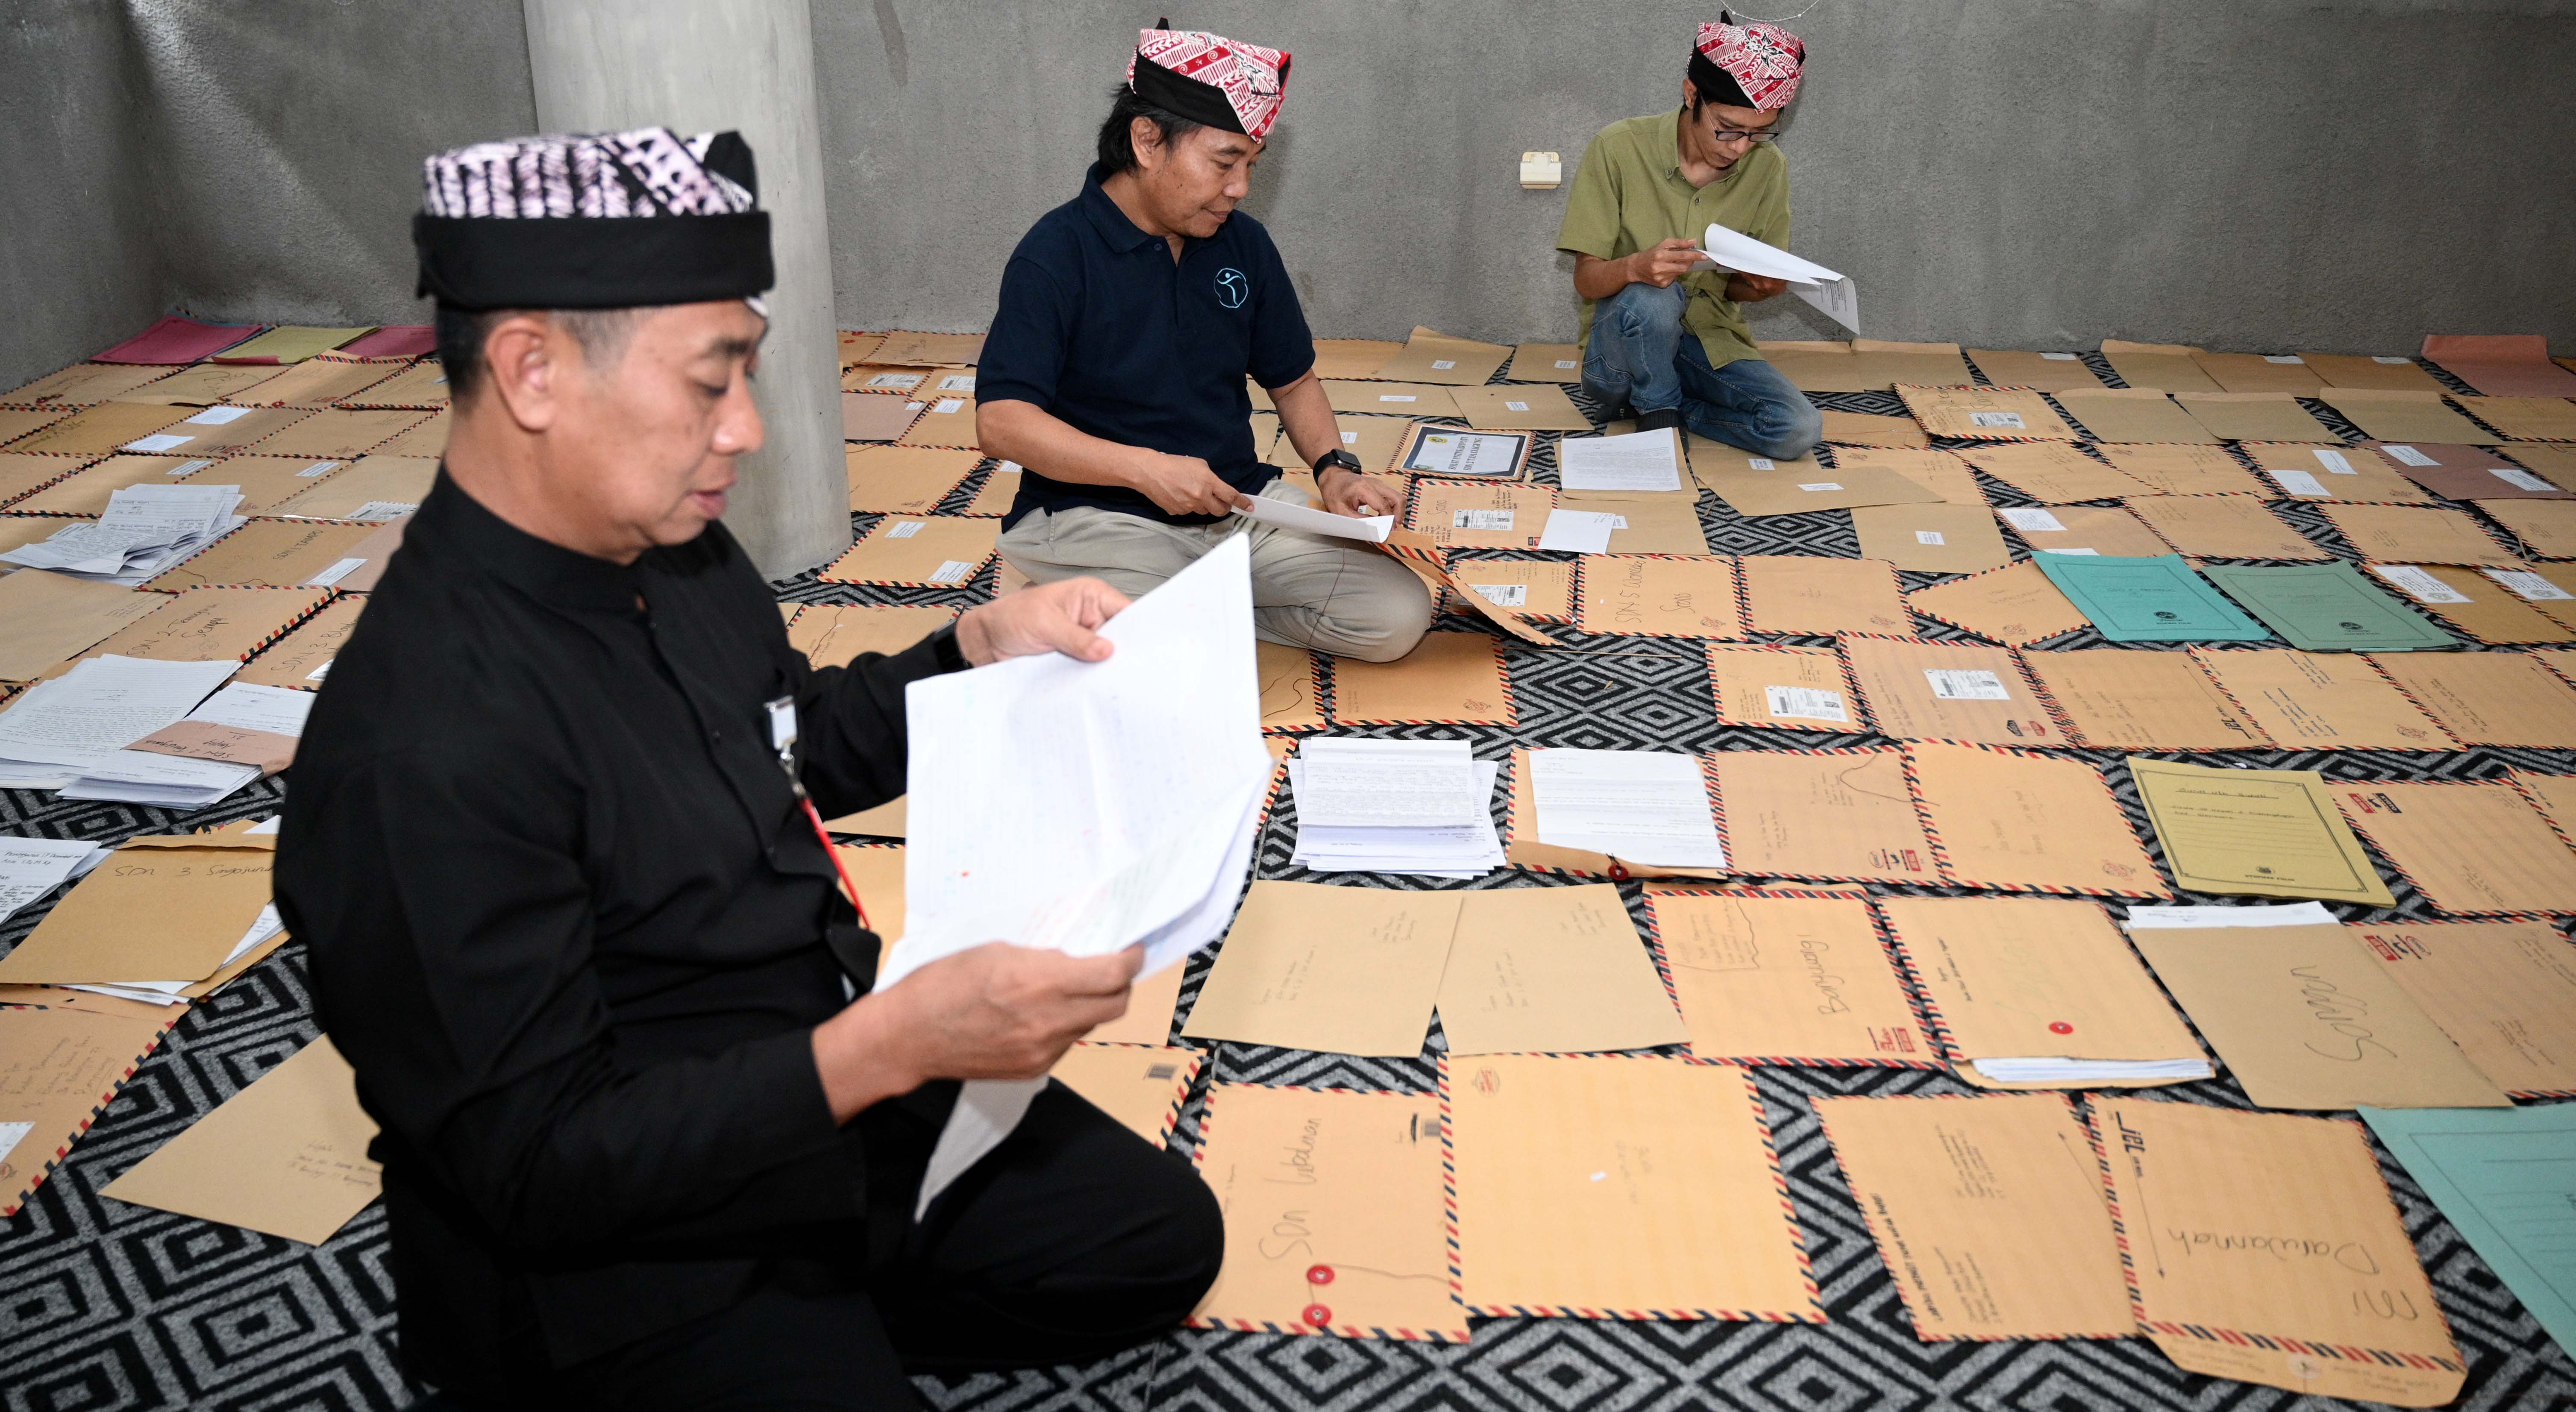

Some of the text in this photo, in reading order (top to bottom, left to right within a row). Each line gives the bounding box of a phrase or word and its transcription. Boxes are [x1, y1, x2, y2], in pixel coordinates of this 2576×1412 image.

[1615, 602, 1642, 623] SDN
[1659, 593, 1695, 614] Srono
[271, 652, 315, 672] SDN
